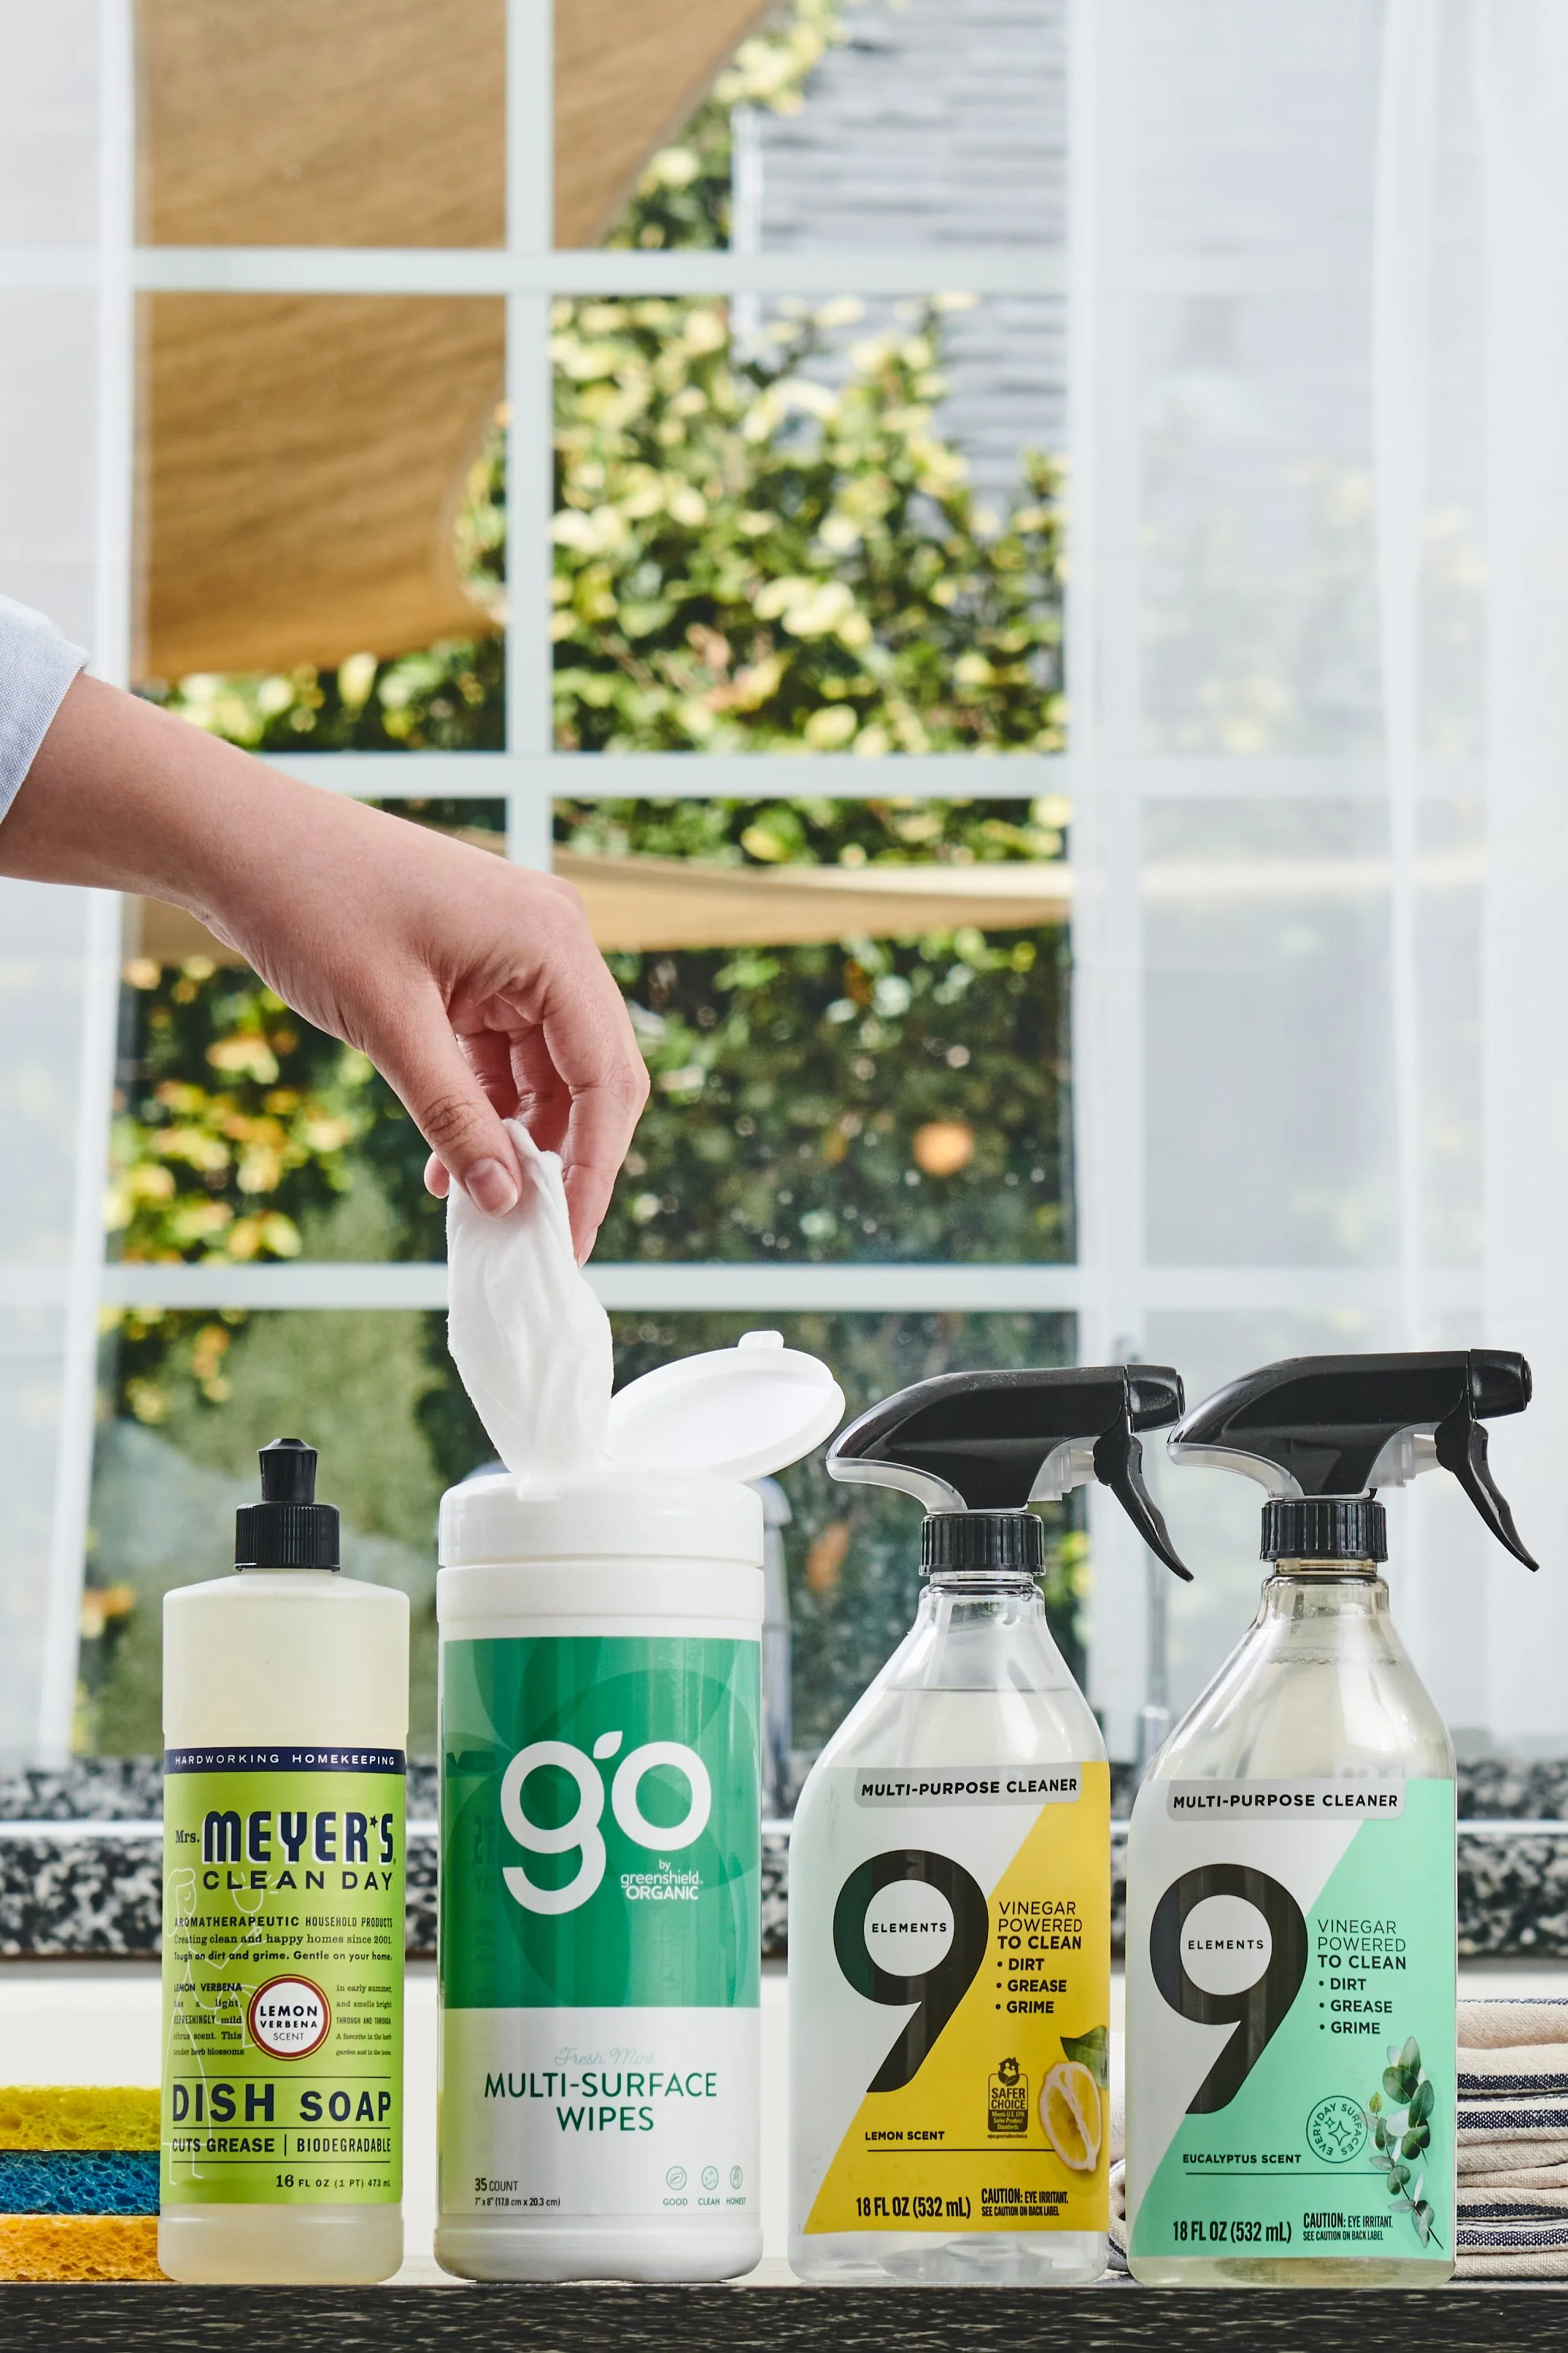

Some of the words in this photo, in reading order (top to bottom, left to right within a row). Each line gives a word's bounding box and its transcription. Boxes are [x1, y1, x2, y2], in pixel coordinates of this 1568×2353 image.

[175, 1755, 279, 1765] HARDWORKING
[292, 1755, 395, 1765] HOMEKEEPING
[862, 1781, 1000, 1796] MULTI-PURPOSE
[1007, 1779, 1077, 1793] CLEANER
[1174, 1794, 1315, 1809] MULTI-PURPOSE
[1322, 1795, 1398, 1807] CLEANER
[175, 1830, 200, 1843] Mrs.
[659, 1860, 671, 1872] by
[203, 1871, 325, 1890] CLEAN
[341, 1871, 393, 1890] DAY
[620, 1871, 699, 1888] greenshield
[625, 1887, 698, 1900] ORGANIC
[999, 1901, 1075, 1915] VINEGAR
[174, 1917, 299, 1927] AROMATHERAPEUTIC
[306, 1917, 357, 1926] HOUSEHOLD
[361, 1917, 393, 1928] PRODUCTS
[872, 1922, 947, 1933] ELEMENTS
[998, 1919, 1083, 1932] POWERED
[1318, 1919, 1397, 1934] VINEGAR
[174, 1935, 207, 1945] Creating
[209, 1934, 237, 1943] clean
[241, 1934, 261, 1943] and
[266, 1934, 304, 1945] happy
[307, 1934, 343, 1944] homes
[347, 1935, 371, 1944] since
[997, 1936, 1021, 1949] TO
[1028, 1936, 1082, 1949] CLEAN
[1189, 1940, 1264, 1949] ELEMENTS
[1318, 1937, 1406, 1952] POWERED
[174, 1952, 192, 1962] Tough
[209, 1951, 225, 1960] dirt
[229, 1951, 249, 1960] and
[253, 1951, 289, 1962] grime.
[294, 1951, 329, 1959] Gentle
[349, 1953, 369, 1962] your
[372, 1952, 392, 1960] home.
[1318, 1955, 1342, 1968] TO
[1348, 1956, 1406, 1970] CLEAN
[833, 1849, 989, 2093] 9
[1008, 1958, 1045, 1971] DIRT
[201, 1983, 242, 1991] VERBENA
[347, 1984, 366, 1993] early
[1008, 1979, 1067, 1992] GREASE
[1150, 1863, 1308, 2114] 9
[1331, 1978, 1367, 1991] DIRT
[260, 2006, 317, 2017] LEMON
[1007, 2000, 1054, 2014] GRIME
[1331, 2000, 1392, 2013] GREASE
[174, 2015, 216, 2024] REFRESHINGLY
[260, 2020, 318, 2028] VERBENA
[1331, 2022, 1380, 2035] GRIME
[274, 2033, 304, 2041] SCENT
[555, 2047, 605, 2067] Fresh
[611, 2048, 655, 2065] Mint
[484, 2073, 717, 2098] MULTI-SURFACE
[992, 2088, 1025, 2098] SAFER
[173, 2084, 274, 2122] DISH
[300, 2091, 391, 2122] SOAP
[992, 2100, 1025, 2109] CHOICE
[557, 2106, 654, 2131] WIPES
[865, 2132, 903, 2141] LEMON
[907, 2131, 945, 2140] SCENT
[1313, 2103, 1337, 2157] EVERYDAY
[1340, 2103, 1363, 2155] SURFACES
[172, 2138, 201, 2152] CUTS
[207, 2138, 274, 2152] GREASE
[297, 2138, 391, 2152] BIODEGRADABLE
[1183, 2154, 1257, 2164] EUCALYPTUS
[1262, 2154, 1301, 2163] SCENT
[276, 2175, 293, 2188] 16
[298, 2179, 310, 2187] FL
[316, 2179, 329, 2187] OZ
[335, 2179, 344, 2189] (1
[349, 2179, 364, 2189] PT)
[368, 2179, 381, 2187] 473
[474, 2178, 487, 2191] 35
[489, 2180, 518, 2192] COUNT
[529, 2198, 544, 2206] 20.3
[546, 2198, 560, 2207] cm)
[726, 2198, 746, 2206] HONEST
[981, 2188, 1023, 2204] CAUTION:
[1024, 2191, 1037, 2203] EYE
[1039, 2191, 1068, 2203] IRRITANT.
[857, 2197, 870, 2217] 18
[874, 2197, 889, 2217] FL
[892, 2197, 909, 2217] OZ
[913, 2197, 943, 2218] (532
[946, 2197, 970, 2218] mL)
[981, 2206, 992, 2217] SEE
[994, 2206, 1018, 2217] CAUTION
[1020, 2206, 1027, 2216] ON
[1028, 2206, 1043, 2216] BACK
[1043, 2206, 1059, 2216] LABEL
[1303, 2213, 1346, 2227] CAUTION:
[1348, 2216, 1361, 2227] EYE
[1363, 2216, 1393, 2227] IRRITANT.
[1173, 2222, 1187, 2241] 18
[1191, 2222, 1205, 2241] FL
[1210, 2222, 1227, 2241] OZ
[1231, 2222, 1260, 2243] (532
[1266, 2222, 1291, 2244] mL)
[1303, 2231, 1315, 2241] SEE
[1316, 2231, 1340, 2241] CAUTION
[1343, 2230, 1350, 2241] ON
[1351, 2230, 1366, 2241] BACK
[1367, 2230, 1383, 2241] LABEL
